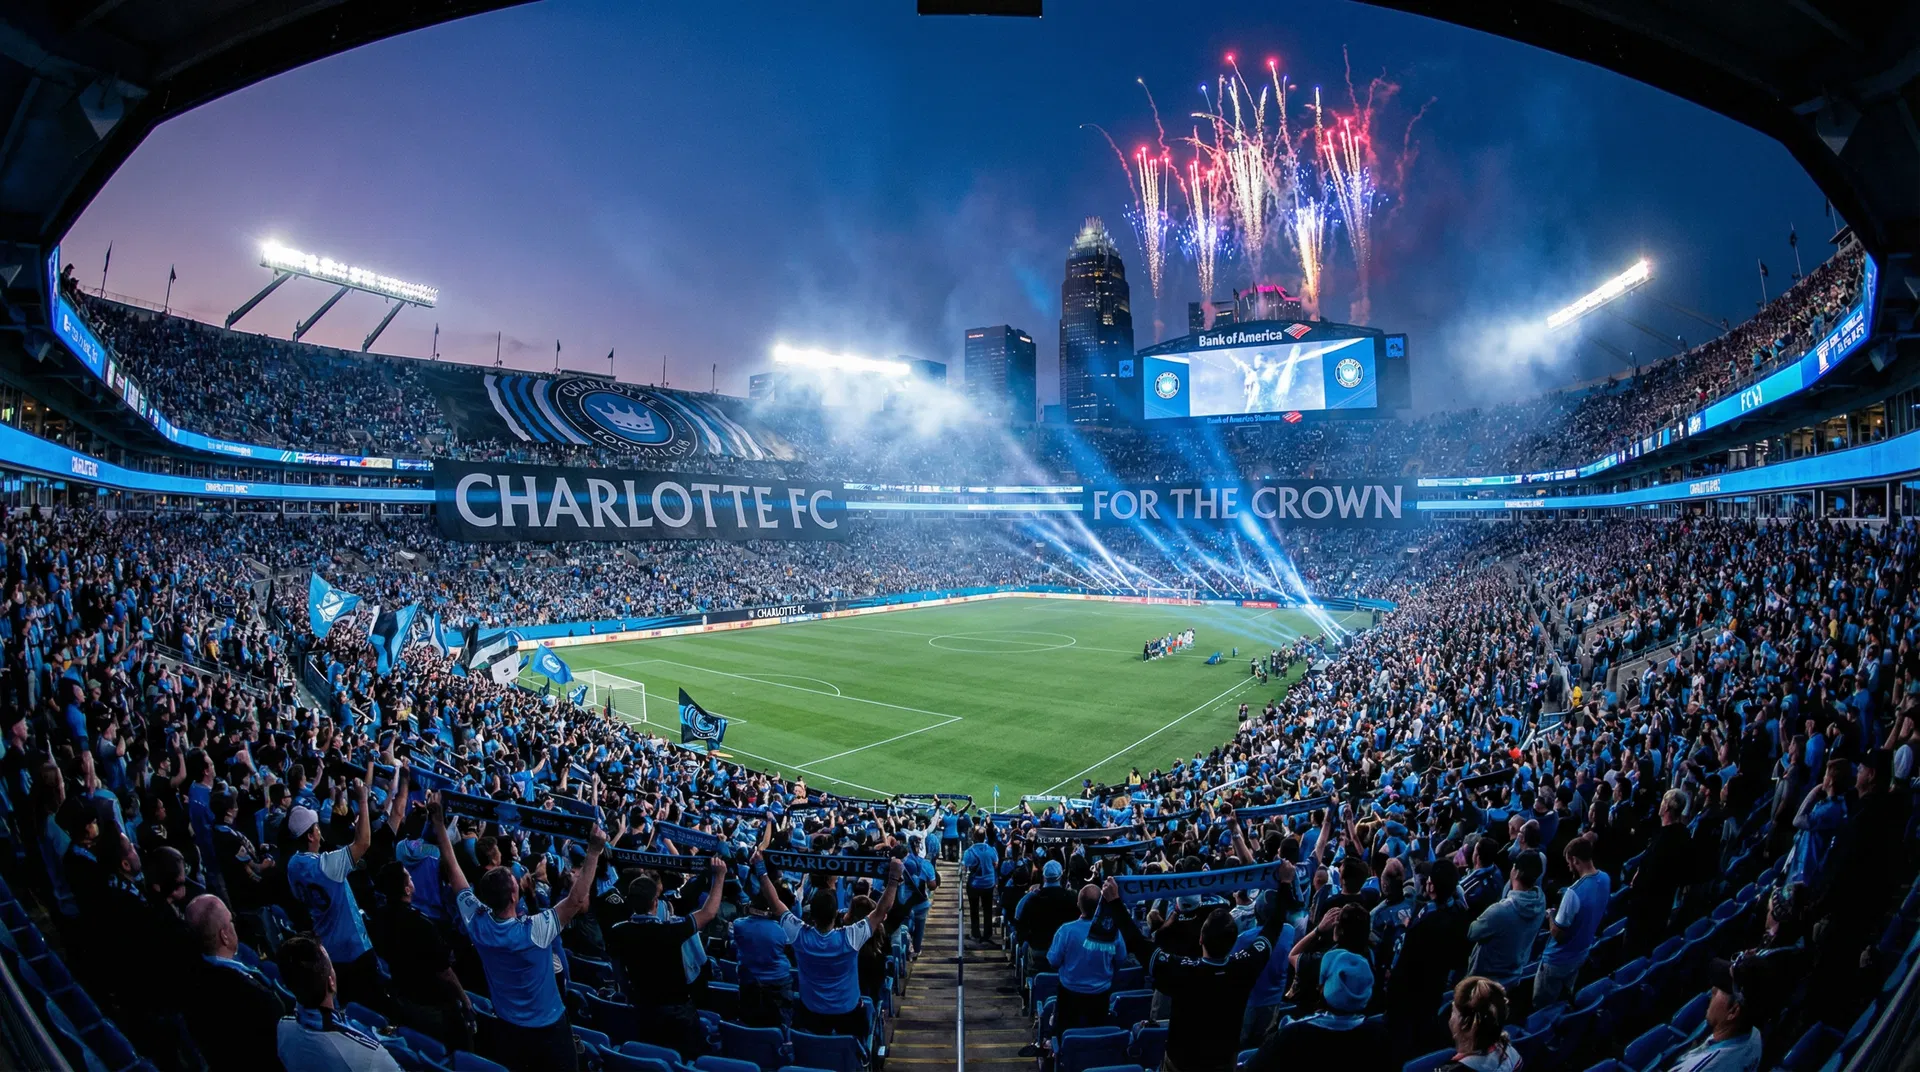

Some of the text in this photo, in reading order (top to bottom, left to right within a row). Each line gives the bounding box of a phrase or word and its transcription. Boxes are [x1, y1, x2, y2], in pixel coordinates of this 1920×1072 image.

[1199, 329, 1282, 347] Bank of America
[562, 380, 657, 407] CHARLOTTE
[455, 473, 838, 529] CHARLOTTE FC
[1093, 485, 1403, 520] FOR THE CROWN
[757, 606, 797, 618] CHARLOTTE
[769, 854, 873, 873] CHARLOTTE
